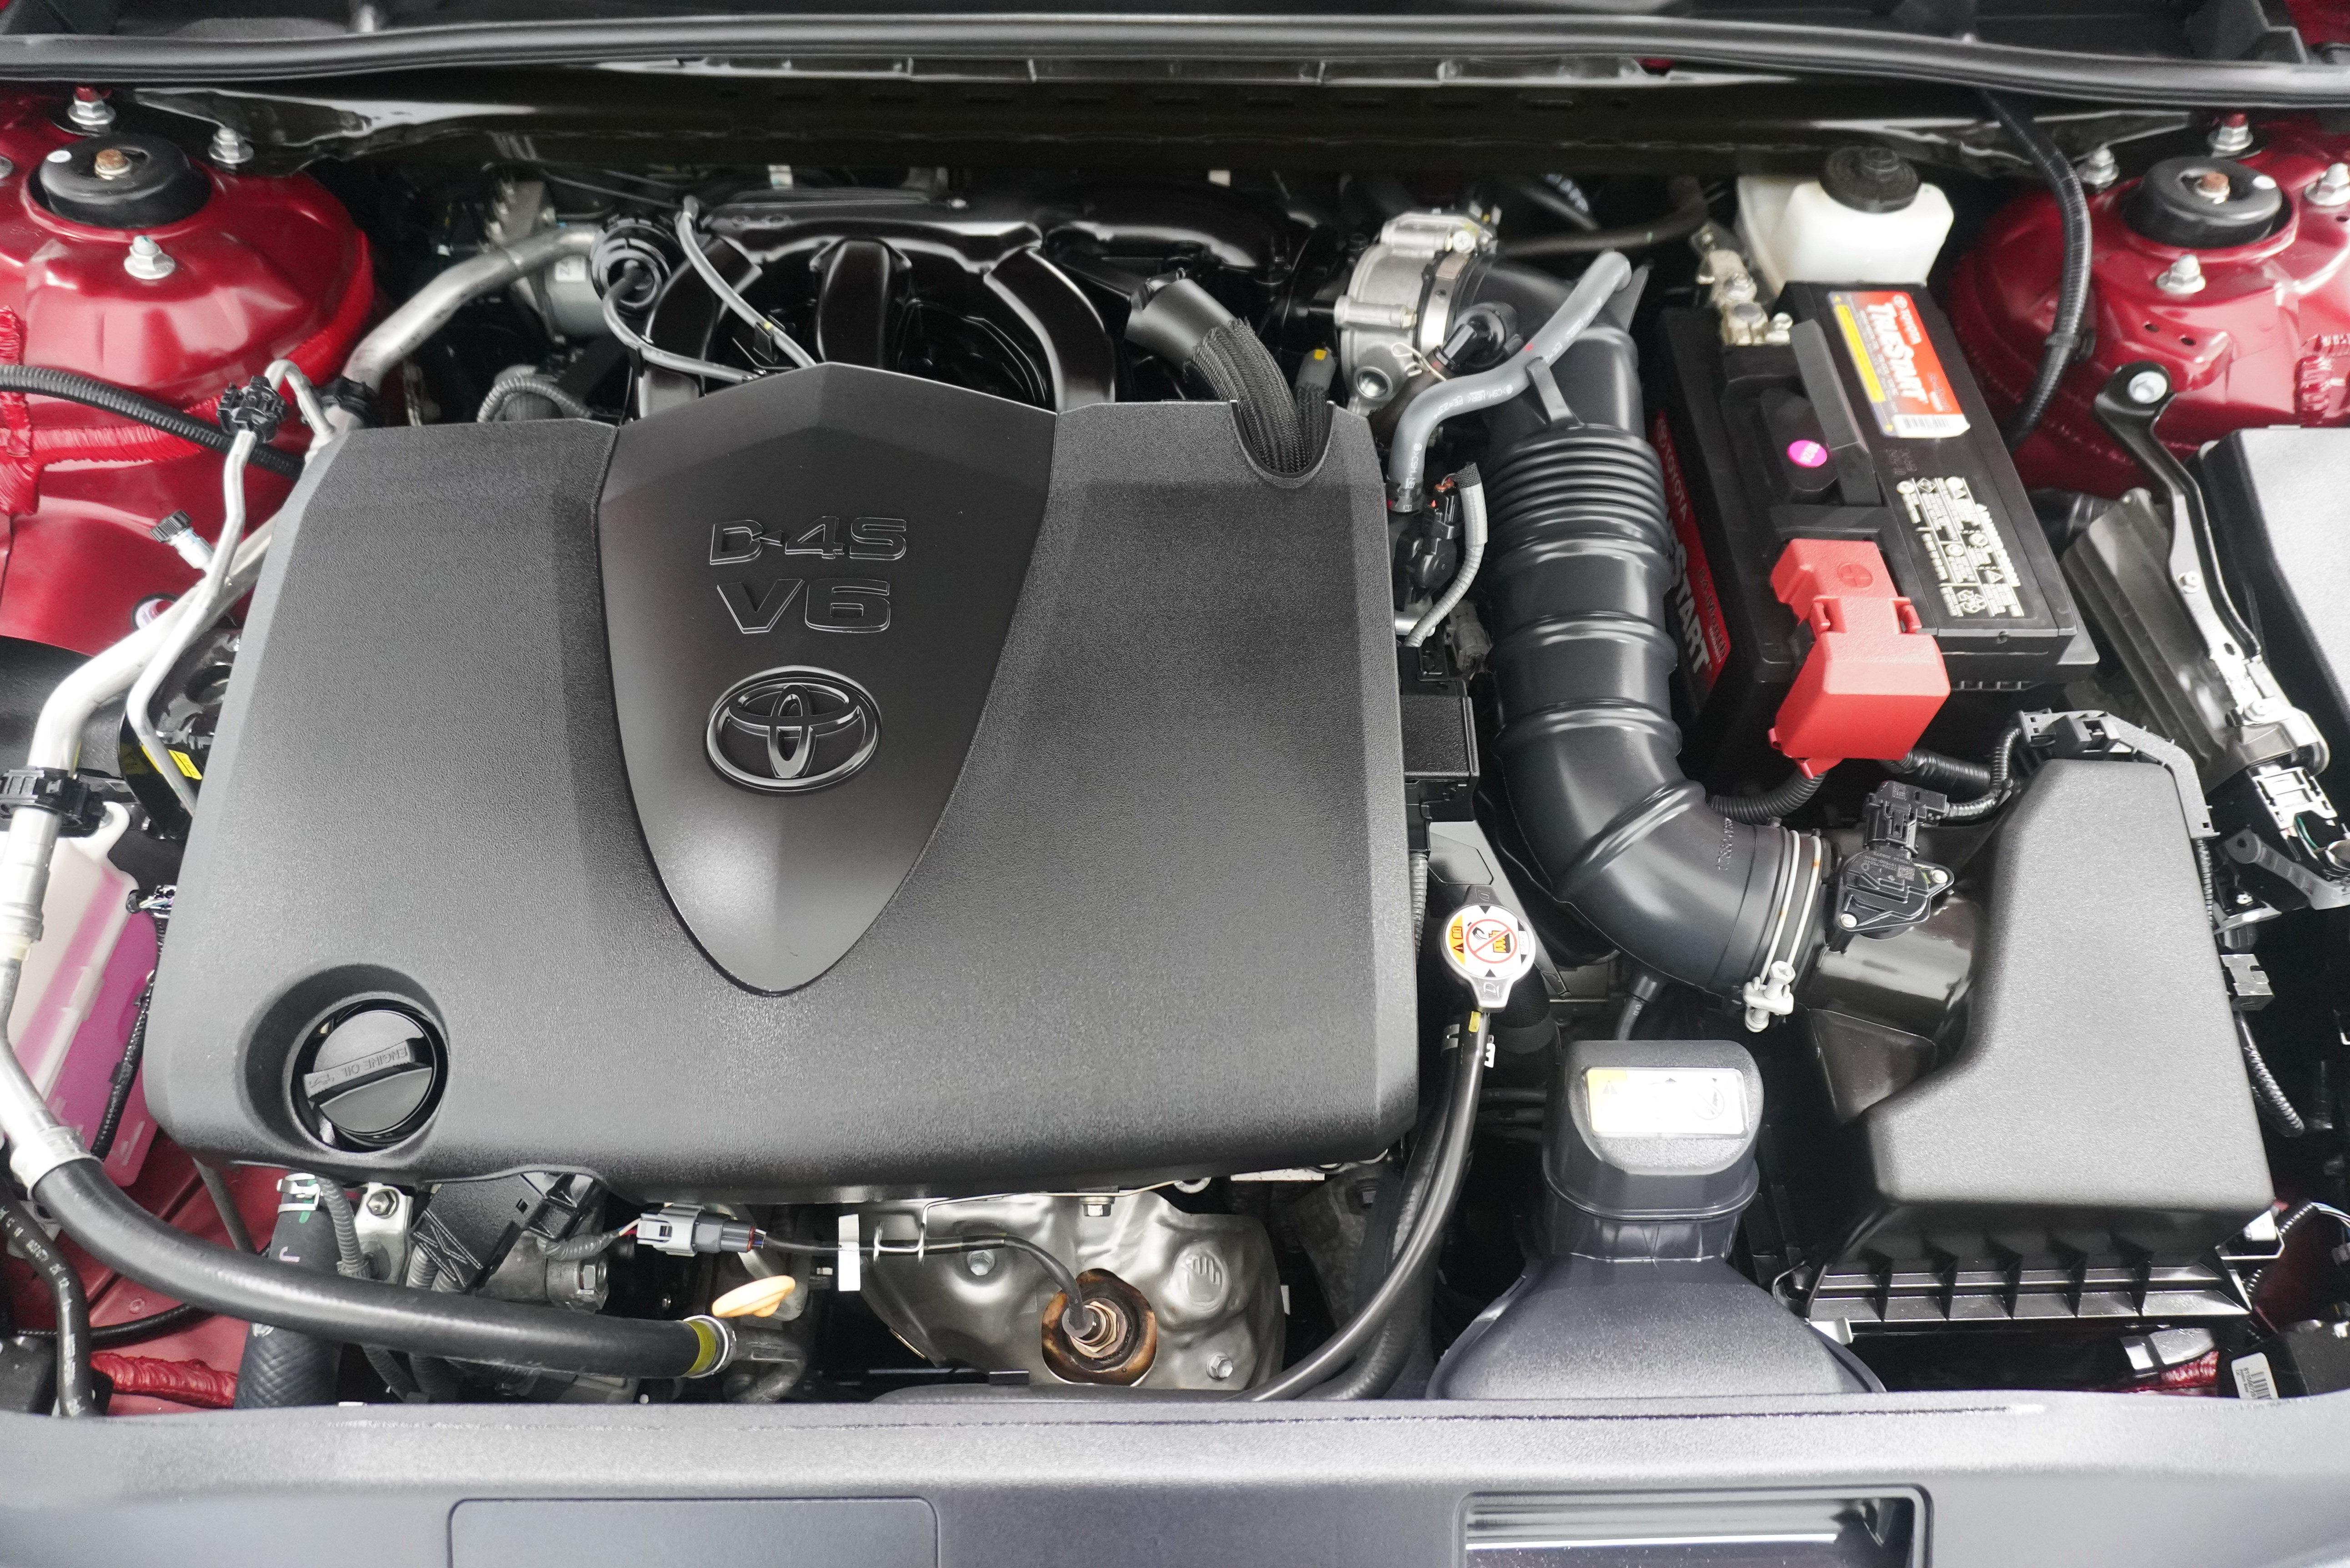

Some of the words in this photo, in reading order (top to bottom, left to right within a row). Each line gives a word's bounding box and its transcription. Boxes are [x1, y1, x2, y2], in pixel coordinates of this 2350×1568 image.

[1899, 308, 1922, 345] TOYOTA
[1664, 447, 1687, 522] TOYOTA
[708, 515, 908, 566] D-4S
[716, 578, 892, 634] V6
[343, 1064, 360, 1076] OIL
[363, 1046, 408, 1070] ENGINE
